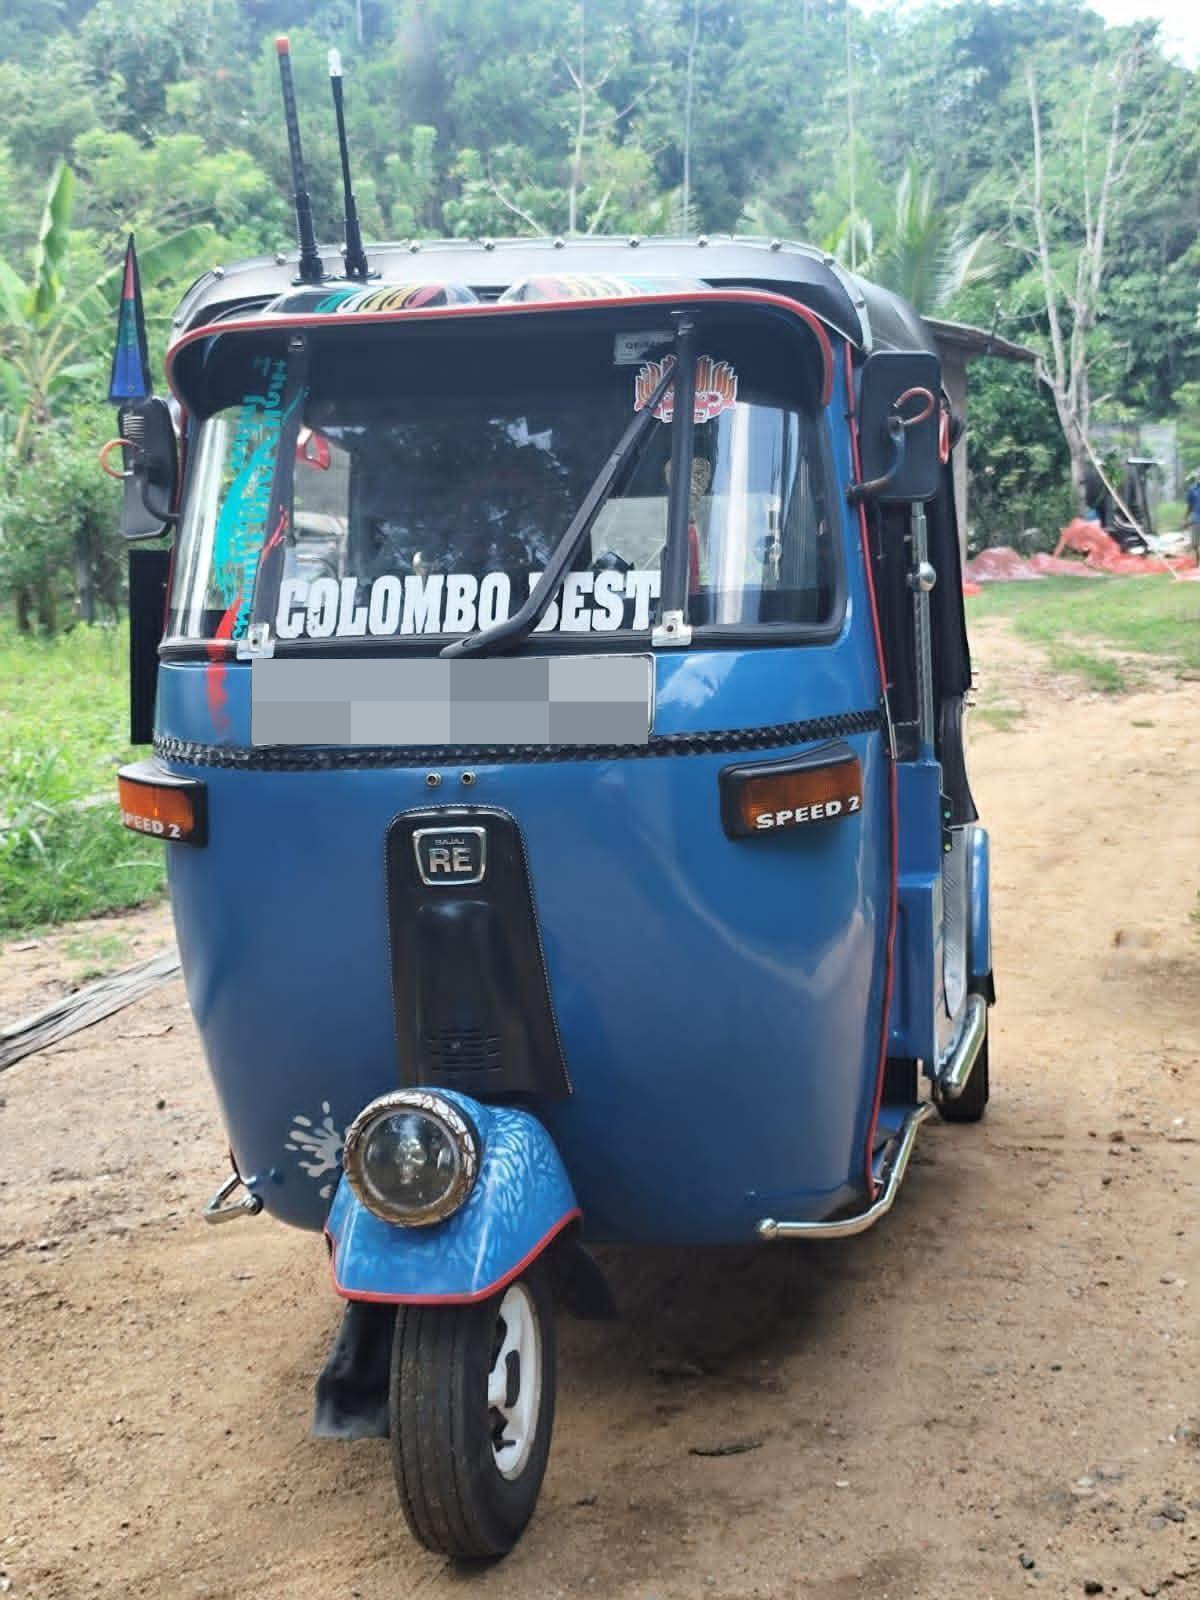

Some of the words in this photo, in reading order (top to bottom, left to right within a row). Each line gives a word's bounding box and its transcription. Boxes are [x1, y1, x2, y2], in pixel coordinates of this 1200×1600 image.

[275, 573, 511, 639] COLOMBO
[756, 800, 842, 829] SPEED
[848, 795, 861, 811] 2
[167, 823, 181, 838] 2
[428, 847, 473, 873] RE
